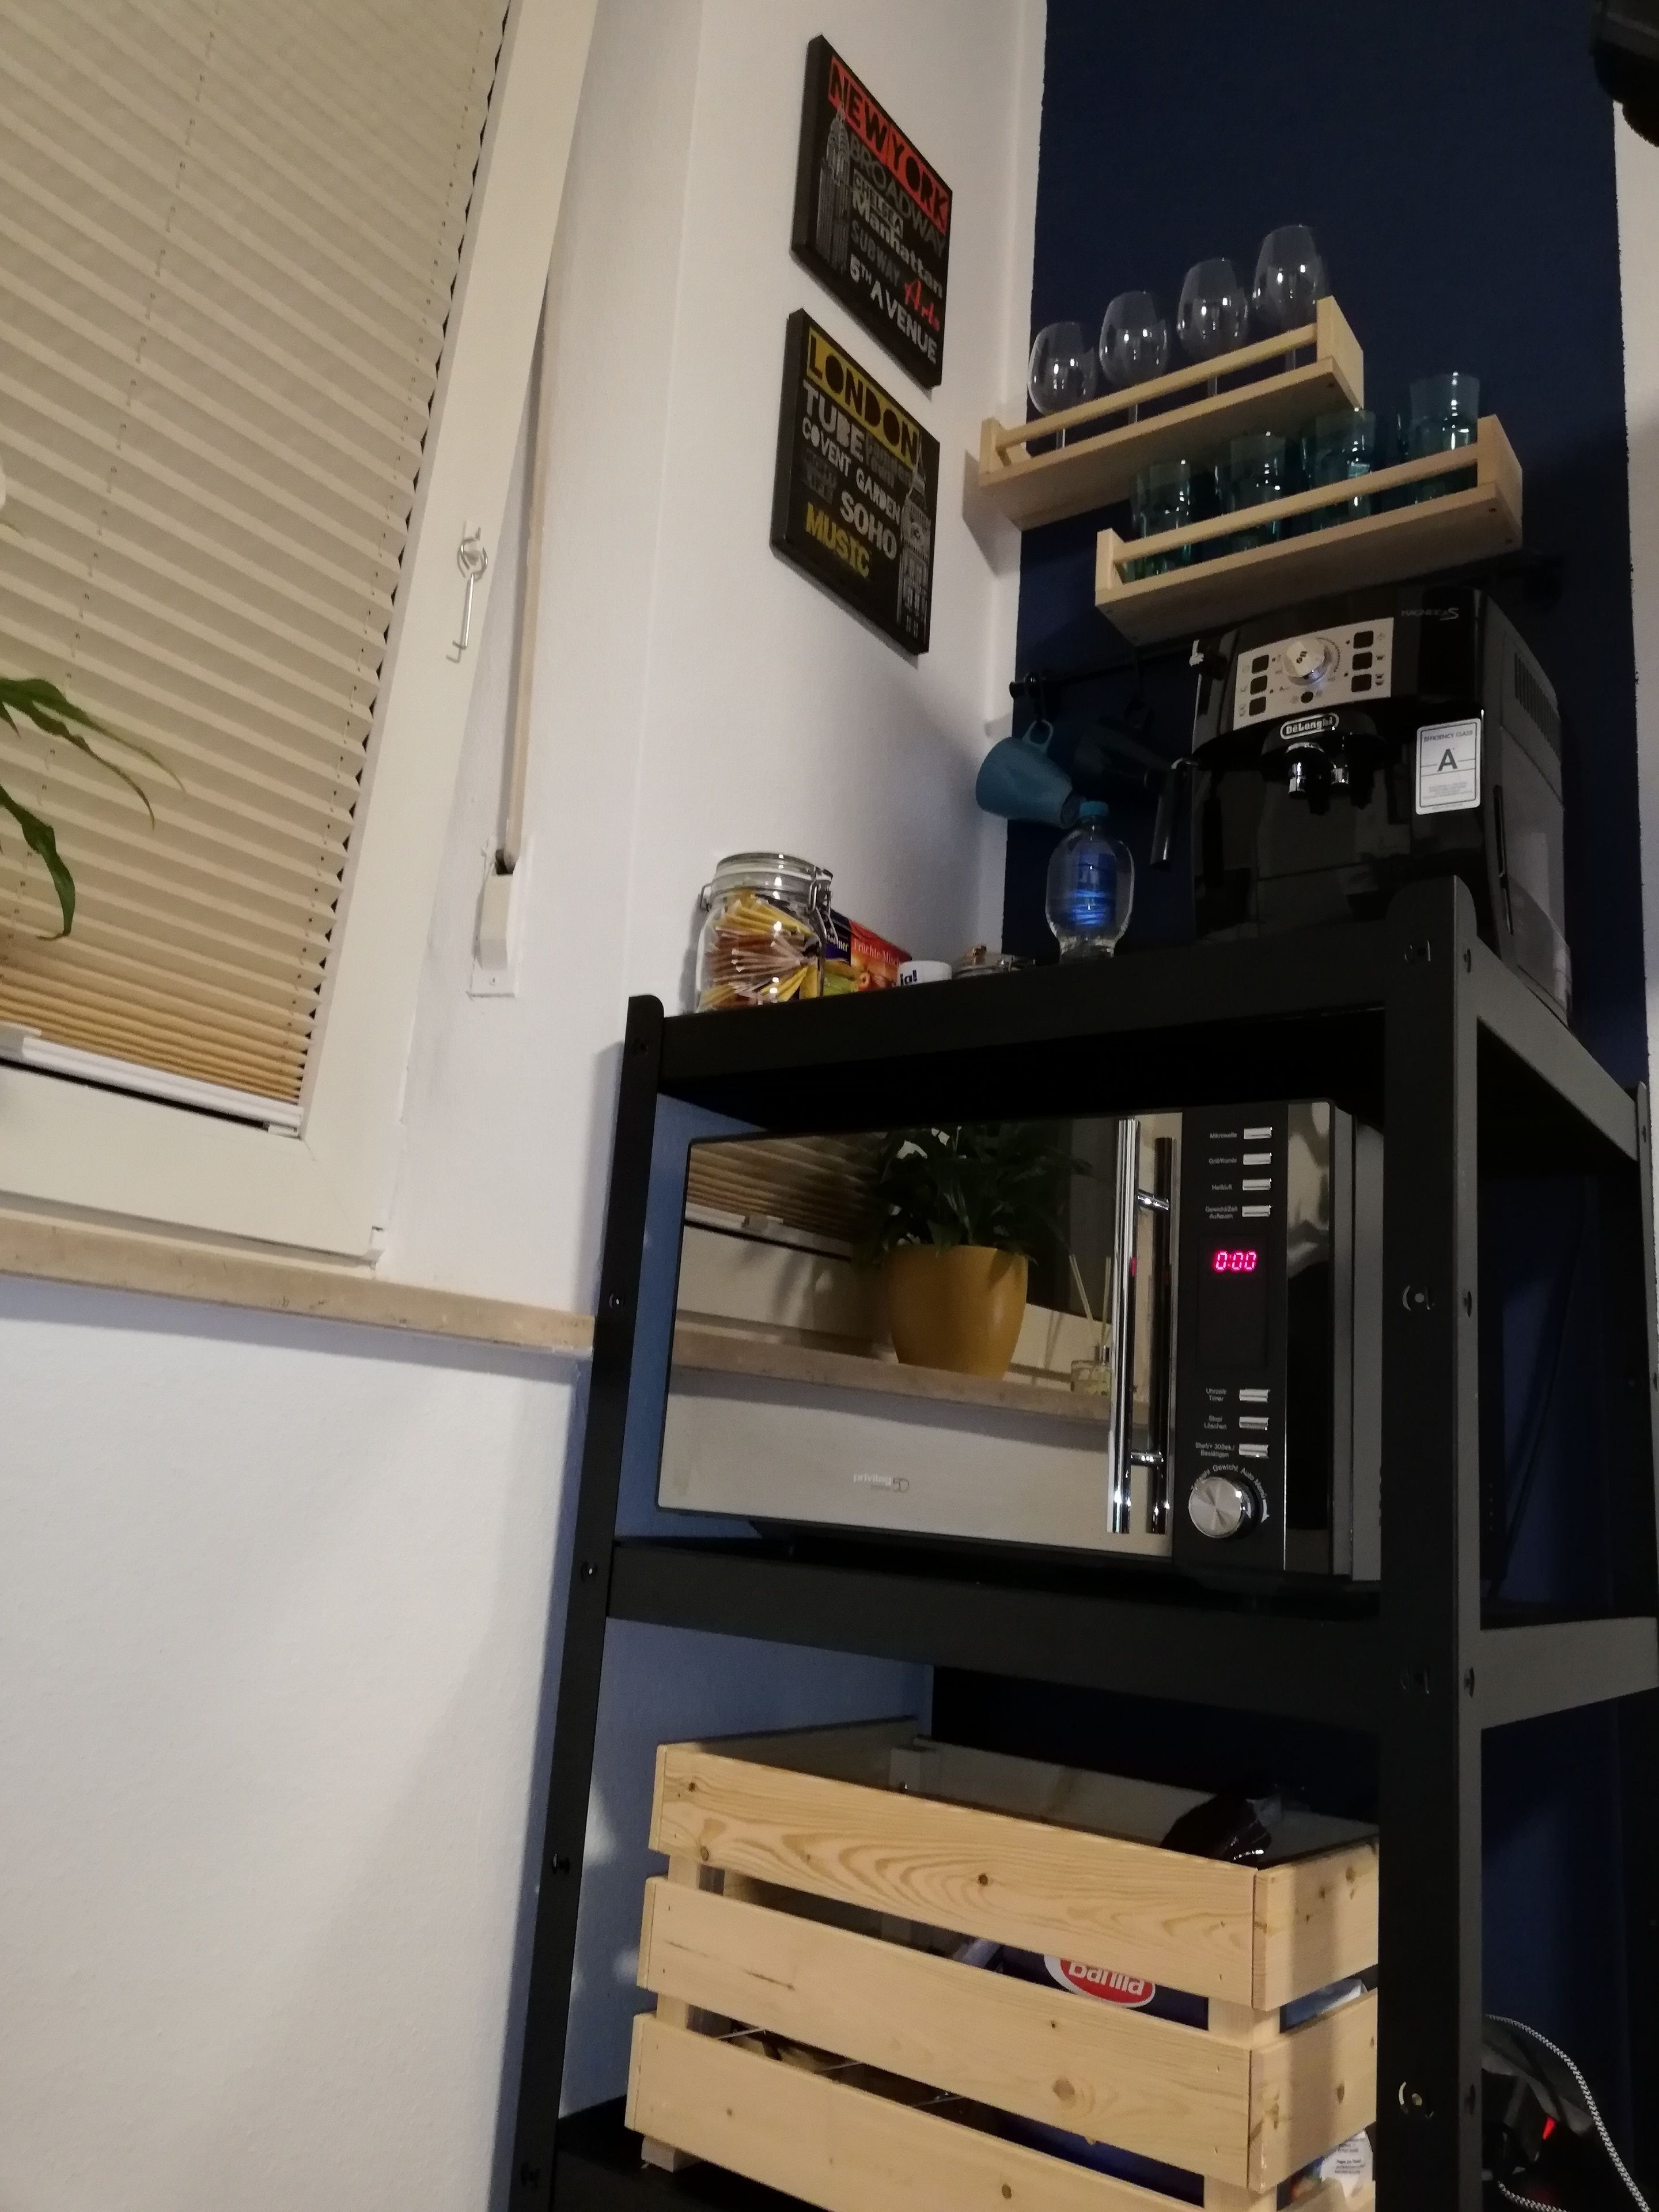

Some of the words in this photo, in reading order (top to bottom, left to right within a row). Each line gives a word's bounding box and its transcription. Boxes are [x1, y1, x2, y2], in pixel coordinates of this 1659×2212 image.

[849, 132, 945, 262] BROADWAY
[850, 218, 900, 289] SUBWAY
[851, 186, 943, 301] Manhattan
[870, 275, 937, 365] AVENUE
[802, 378, 865, 464] TUBE
[809, 334, 917, 467] LONDON
[802, 415, 851, 479] COVENT
[855, 465, 901, 527] GARDEN
[805, 500, 870, 581] MUSIC
[839, 487, 897, 564] SOHO
[1424, 733, 1454, 743] EFFICIENCY
[1437, 748, 1458, 772] A
[1215, 1252, 1256, 1270] 0:00
[1213, 1464, 1238, 1472] Gewicht
[1240, 1467, 1255, 1481] Auto
